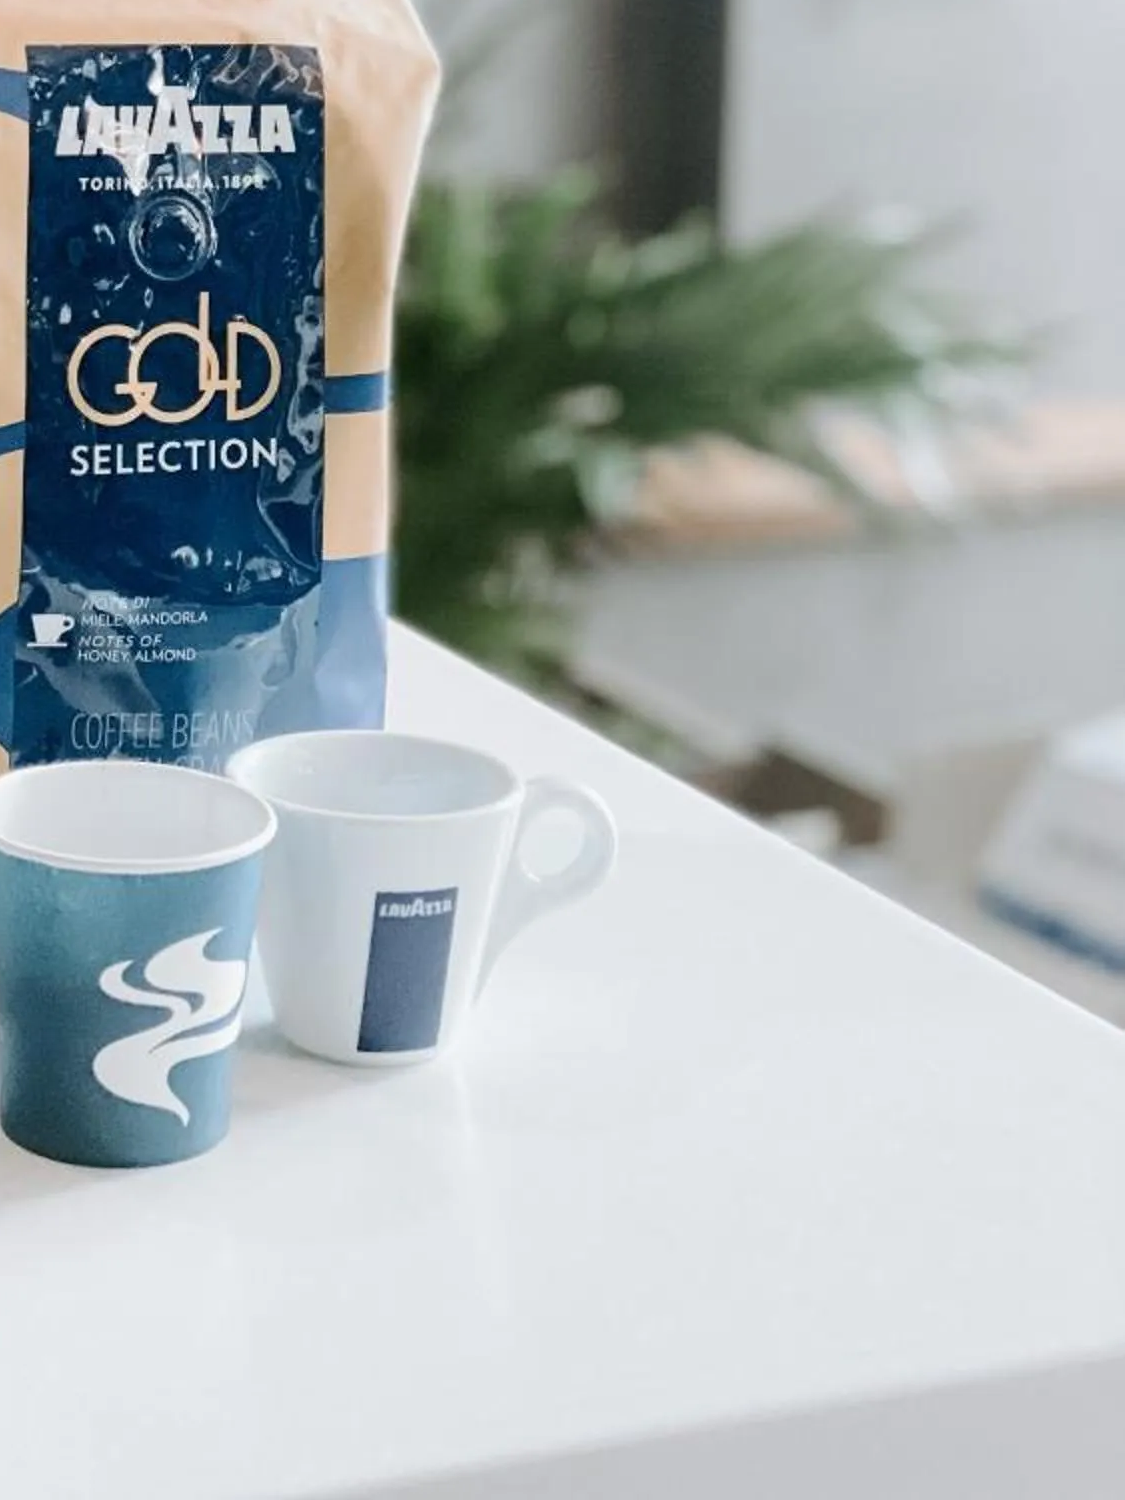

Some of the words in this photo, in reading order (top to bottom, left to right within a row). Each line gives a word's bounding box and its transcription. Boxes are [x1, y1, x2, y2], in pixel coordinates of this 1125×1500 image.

[56, 85, 296, 157] LAVAZZA
[66, 291, 282, 427] GOLD
[70, 437, 278, 477] SELECTION
[128, 610, 209, 627] MANDORLA
[78, 634, 135, 649] NOTES
[139, 632, 164, 648] OF
[135, 647, 197, 663] ALMOND
[70, 711, 165, 750] COFFEE
[171, 709, 255, 749] BEANS
[378, 896, 453, 919] LAVAZZA
